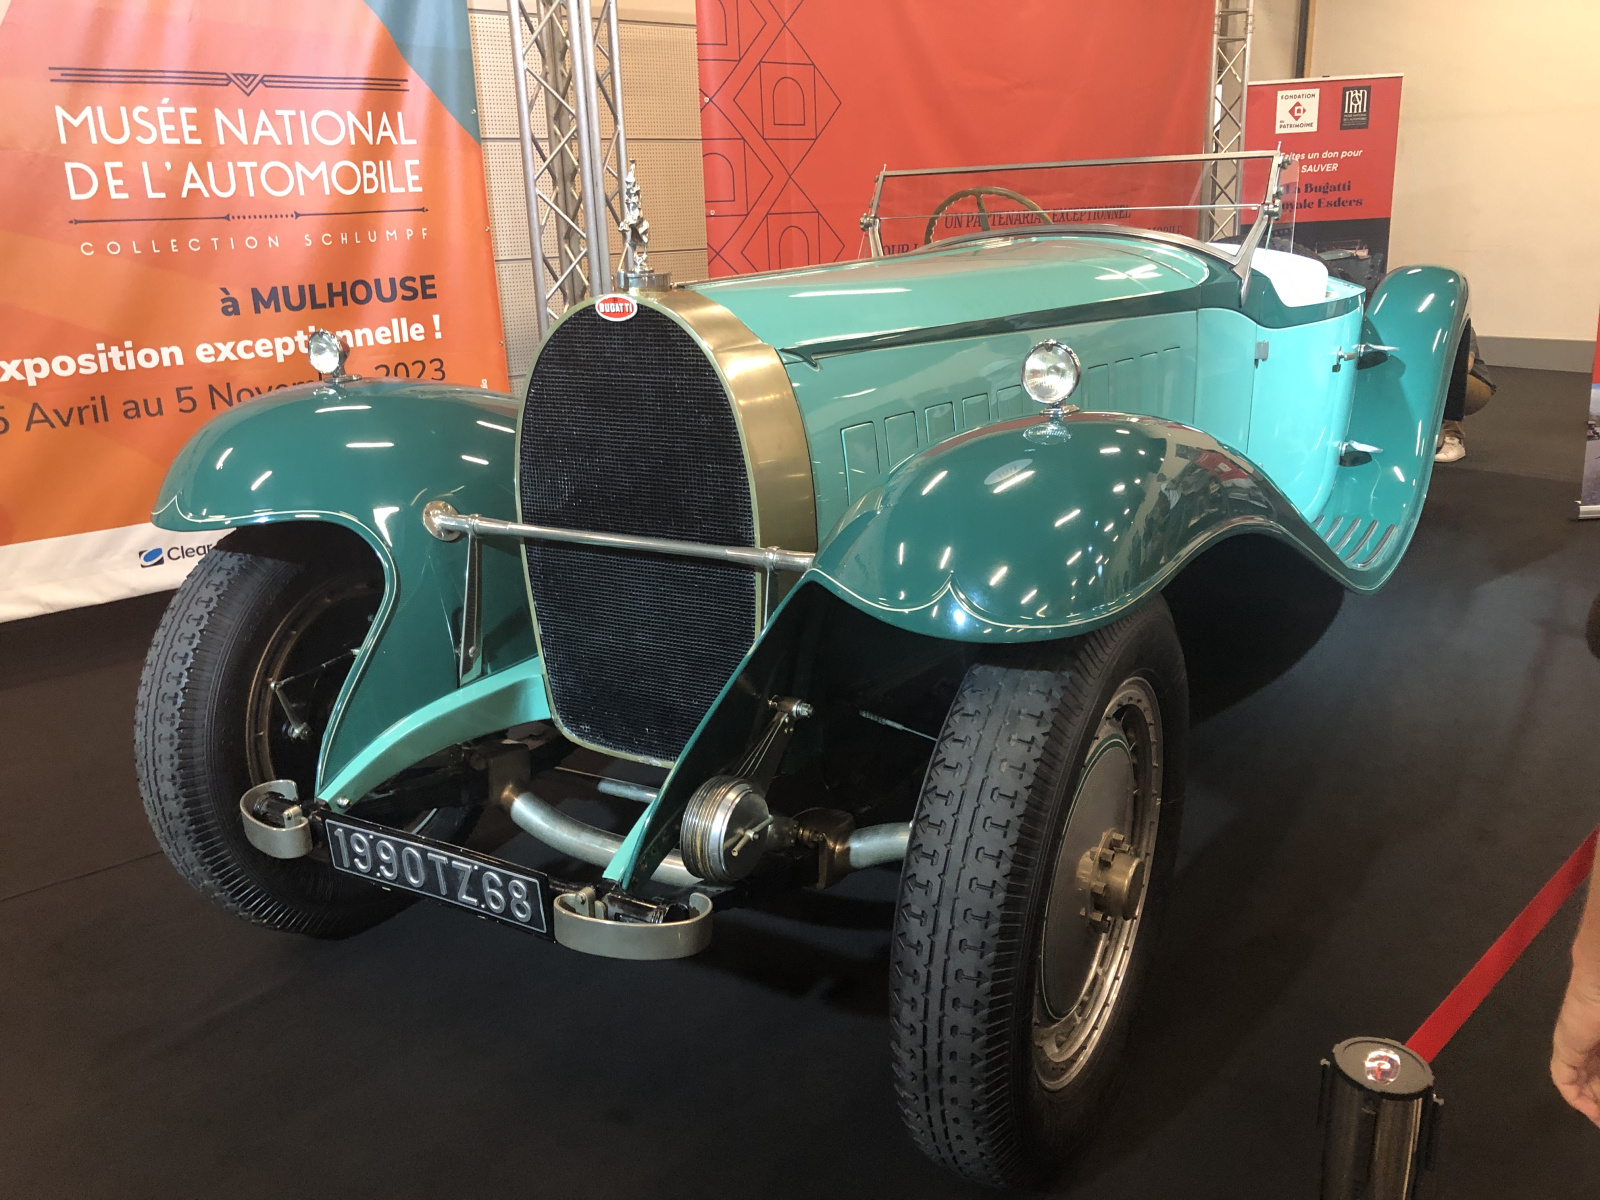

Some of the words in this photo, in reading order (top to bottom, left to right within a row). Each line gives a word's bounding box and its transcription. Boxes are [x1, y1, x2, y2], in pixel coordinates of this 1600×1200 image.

[55, 97, 202, 144] MUSÉE
[214, 107, 417, 146] NATIONAL
[1321, 150, 1339, 159] don
[1340, 150, 1363, 159] pour
[1300, 163, 1339, 173] SAUVER
[64, 161, 130, 200] DE
[1304, 181, 1352, 195] Bugatti
[944, 213, 965, 229] UN
[966, 208, 1049, 228] PATENARIA
[1052, 205, 1131, 223] EXCEPTIONNEL
[1281, 198, 1314, 213] oyale
[1317, 197, 1363, 208] Esders
[80, 236, 280, 256] COLLECTION
[303, 228, 428, 247] SCHLUMPF
[220, 287, 241, 316] à
[251, 275, 437, 314] MULHOUSE
[599, 303, 633, 313] BUGATTI
[195, 317, 426, 363] exceptnnelle
[25, 395, 110, 432] Avril
[122, 397, 164, 421] au
[175, 386, 198, 414] 5
[167, 544, 212, 561] Clear
